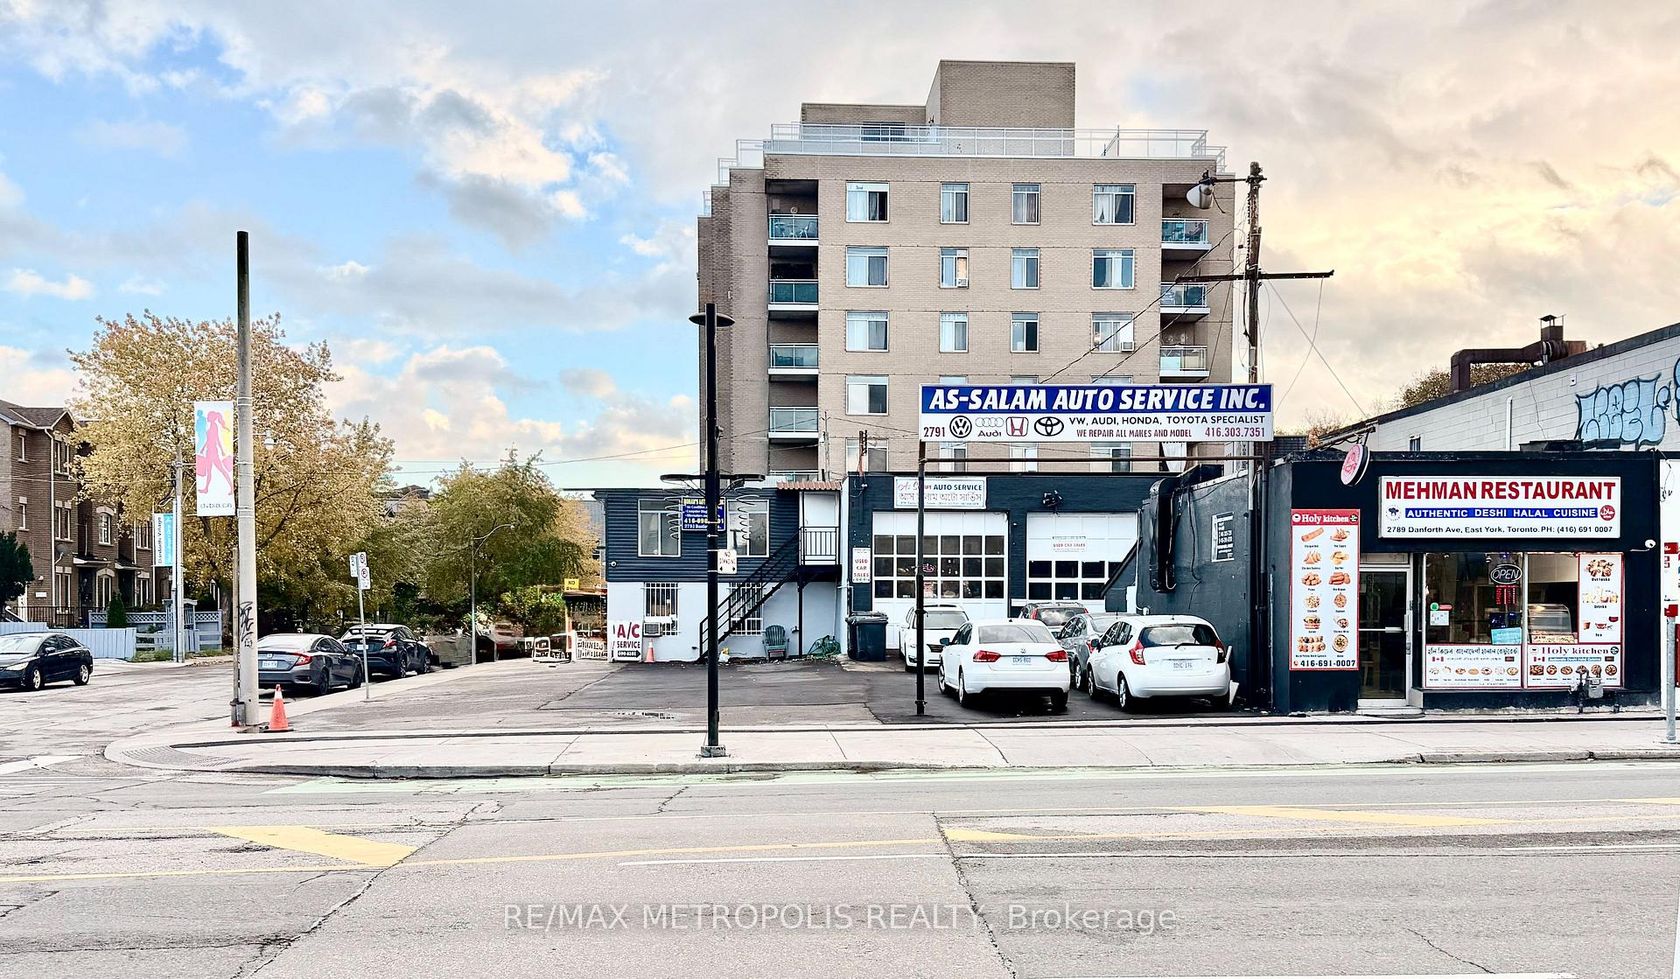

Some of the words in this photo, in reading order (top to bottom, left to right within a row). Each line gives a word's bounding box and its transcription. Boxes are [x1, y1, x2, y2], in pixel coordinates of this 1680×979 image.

[929, 389, 1047, 410] AS-SALAM
[1052, 389, 1114, 410] AUTO
[1119, 388, 1219, 410] SERVICE
[1219, 388, 1266, 409] INC.
[1069, 417, 1088, 426] VW,
[1091, 417, 1119, 426] AUDI,
[1122, 417, 1162, 426] HONDA,
[1166, 416, 1208, 424] TOYOTA
[1211, 415, 1266, 424] SPECIALIST
[923, 426, 946, 438] 2791
[977, 429, 1002, 437] Audi
[1076, 429, 1087, 438] WE
[1088, 429, 1114, 438] REPAIR
[1116, 429, 1127, 438] ALL
[1128, 429, 1151, 438] MAKES
[1153, 429, 1168, 438] AND
[1169, 429, 1192, 438] MODEL
[1204, 427, 1266, 438] 416.303.7351
[1386, 481, 1477, 500] MEHMAN
[1481, 481, 1616, 500] RESTAURANT
[1301, 513, 1322, 524] Holy
[1322, 513, 1349, 523] kitchen
[1406, 509, 1468, 518] AUTHENTIC
[1474, 508, 1507, 517] DESHI
[1513, 508, 1548, 517] HALAL
[1553, 508, 1596, 517] CUISINE
[1556, 526, 1577, 534] (416)
[1492, 568, 1520, 579] OPEN
[617, 622, 640, 640] A/C
[617, 640, 641, 649] SERVICE
[1542, 646, 1569, 656] Holy
[1572, 646, 1609, 654] kitchen
[1300, 659, 1356, 667] 416-691-0007
